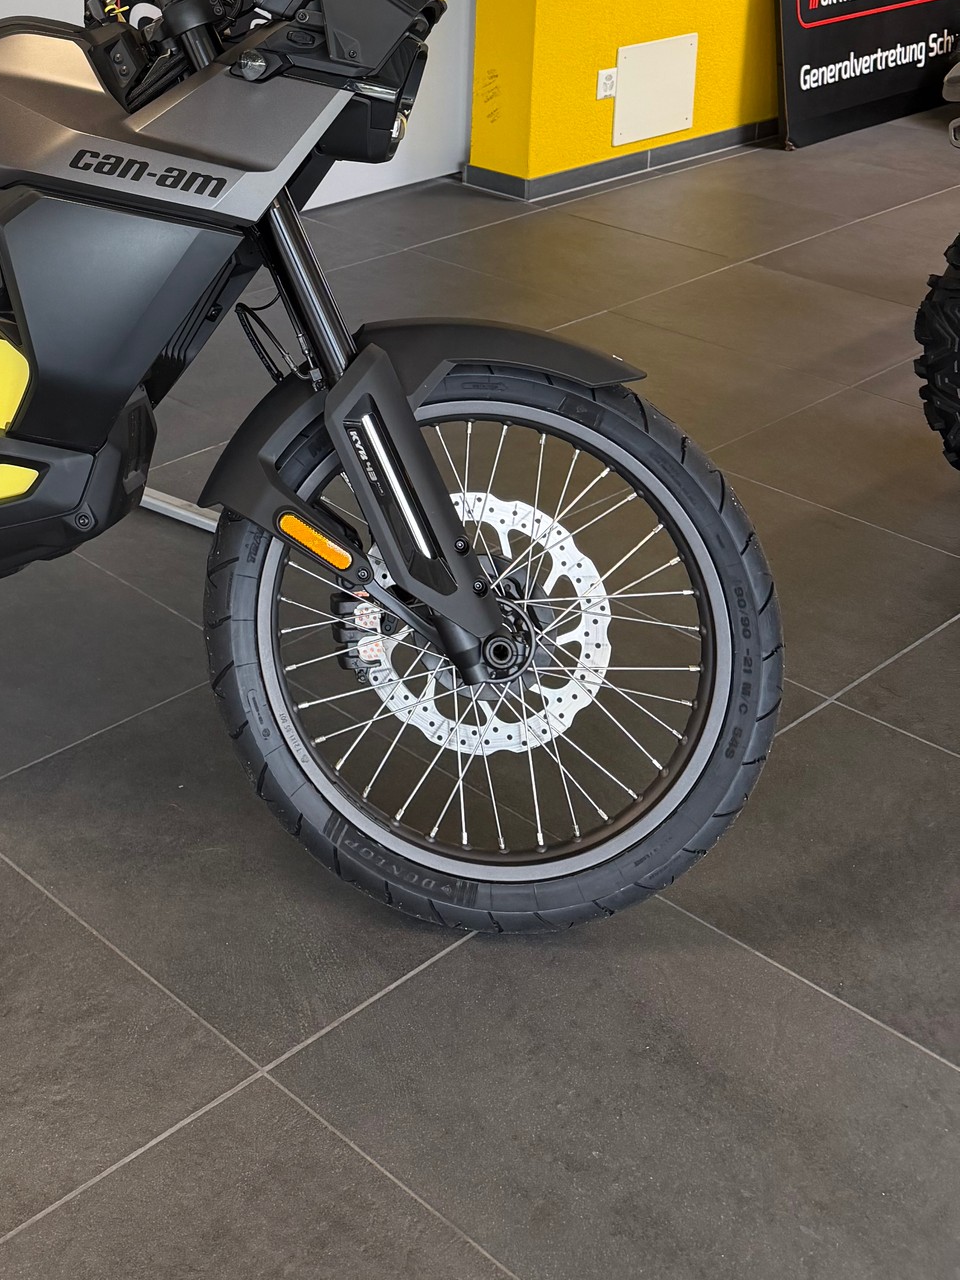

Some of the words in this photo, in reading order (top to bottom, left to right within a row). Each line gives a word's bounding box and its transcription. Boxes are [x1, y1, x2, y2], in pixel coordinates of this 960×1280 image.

[800, 41, 926, 91] Generalvertretung
[928, 29, 955, 58] Sch
[69, 149, 227, 198] can-am
